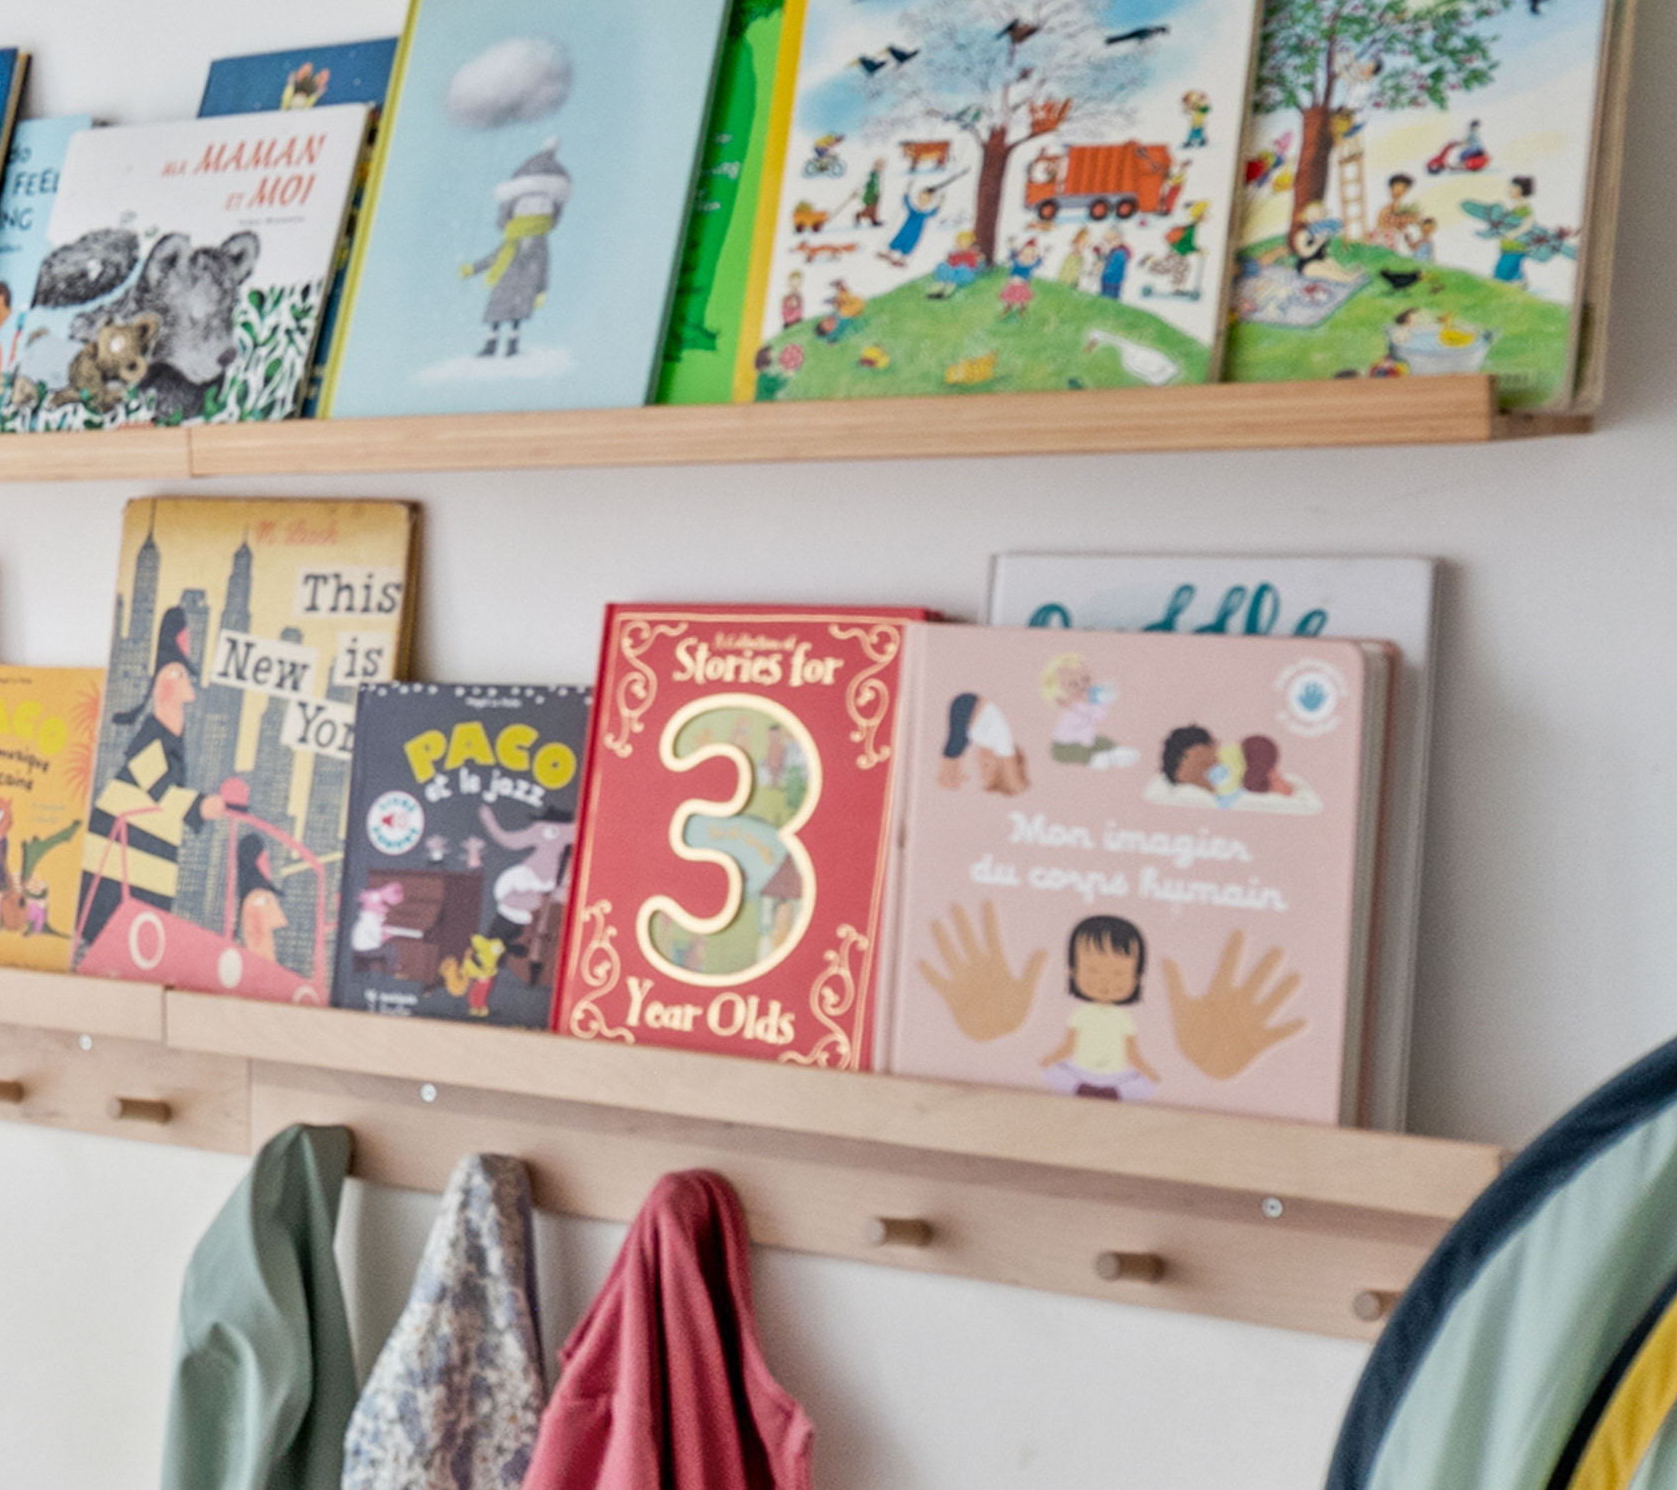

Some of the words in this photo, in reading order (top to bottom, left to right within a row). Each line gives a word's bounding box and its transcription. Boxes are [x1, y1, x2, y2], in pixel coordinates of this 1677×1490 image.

[193, 133, 327, 175] MAMAN
[248, 173, 316, 209] MOI
[303, 573, 403, 613] This
[218, 637, 309, 692] New
[344, 637, 384, 678] is
[671, 637, 783, 686] Stories
[788, 641, 844, 687] for
[298, 701, 354, 751] Yor
[403, 720, 577, 790] PACO
[424, 773, 453, 803] et
[459, 766, 481, 794] le
[482, 768, 545, 808] jazz
[636, 692, 822, 987] 3
[1006, 810, 1096, 851] Mon
[1102, 821, 1254, 867] imagier
[969, 854, 1022, 887] du
[1027, 865, 1131, 902] corps
[1144, 867, 1289, 917] humain
[624, 975, 702, 1033] Year
[707, 991, 796, 1046] Olds
